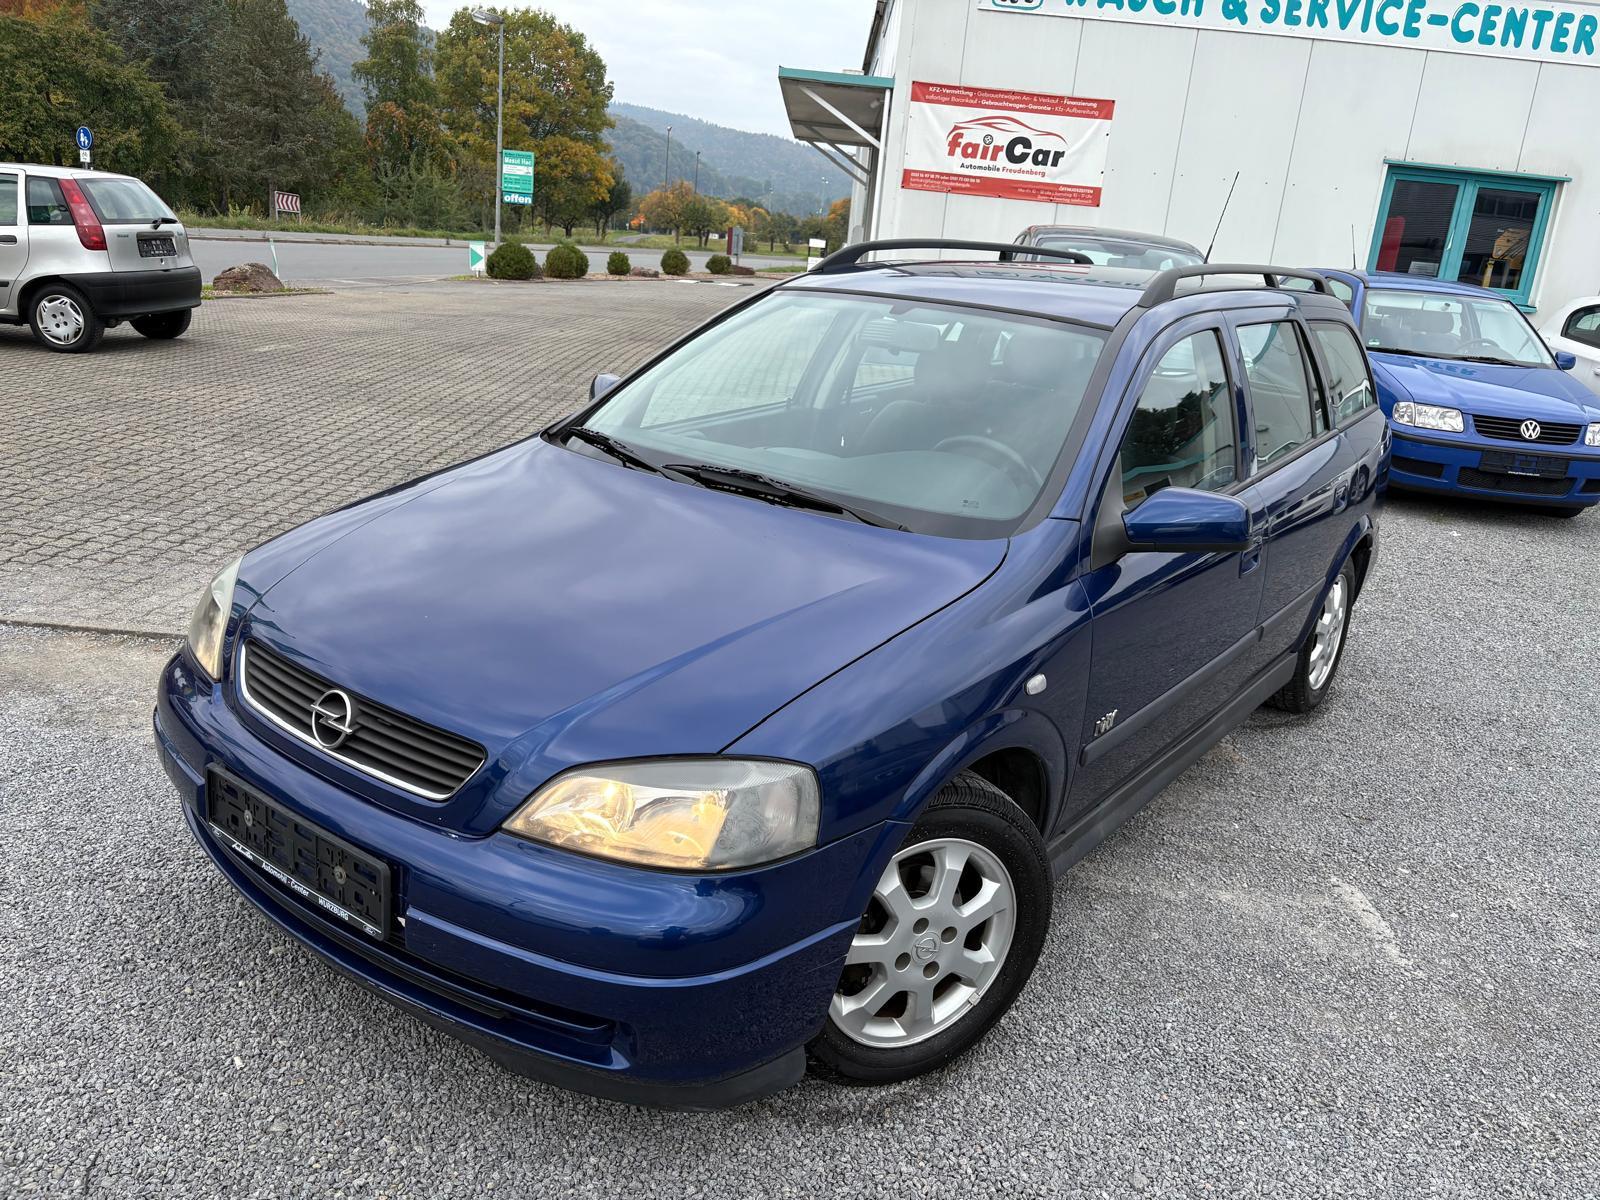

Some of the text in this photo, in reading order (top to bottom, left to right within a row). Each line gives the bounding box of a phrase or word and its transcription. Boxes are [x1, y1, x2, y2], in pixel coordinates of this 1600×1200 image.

[1222, 0, 1249, 25] &
[1260, 0, 1598, 55] SERVICE-CENTER
[929, 86, 973, 97] KFZ-Vermittlung
[977, 90, 1021, 101] Gebrauchtwagen
[1063, 99, 1098, 108] Finanzierung
[981, 100, 1052, 111] Gebrauchtwagen-Garantie
[947, 132, 1066, 168] fairCar
[959, 162, 1047, 177] Automobile Freudenberg
[504, 194, 532, 203] offen
[290, 880, 310, 897] Center
